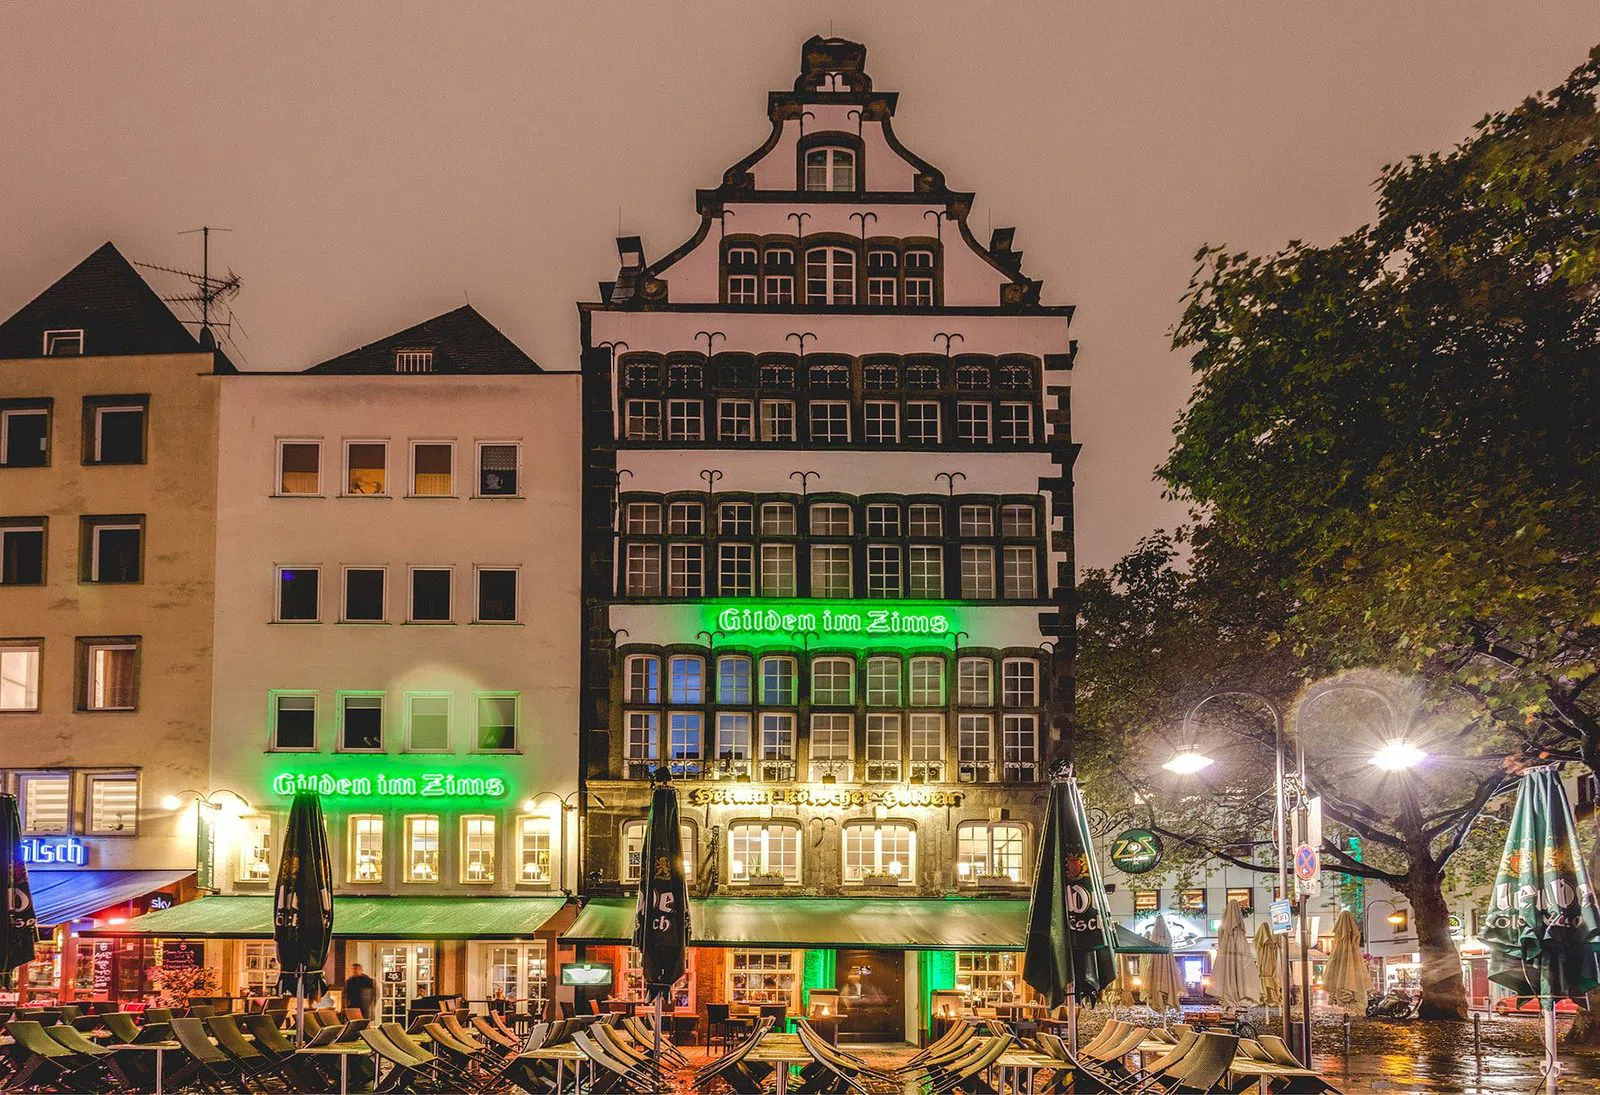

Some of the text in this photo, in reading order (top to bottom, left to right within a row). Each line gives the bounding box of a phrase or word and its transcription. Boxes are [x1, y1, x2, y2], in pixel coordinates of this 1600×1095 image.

[718, 608, 948, 633] Gilden im Zims
[273, 772, 505, 797] Gilden im Zims
[151, 897, 171, 909] sky
